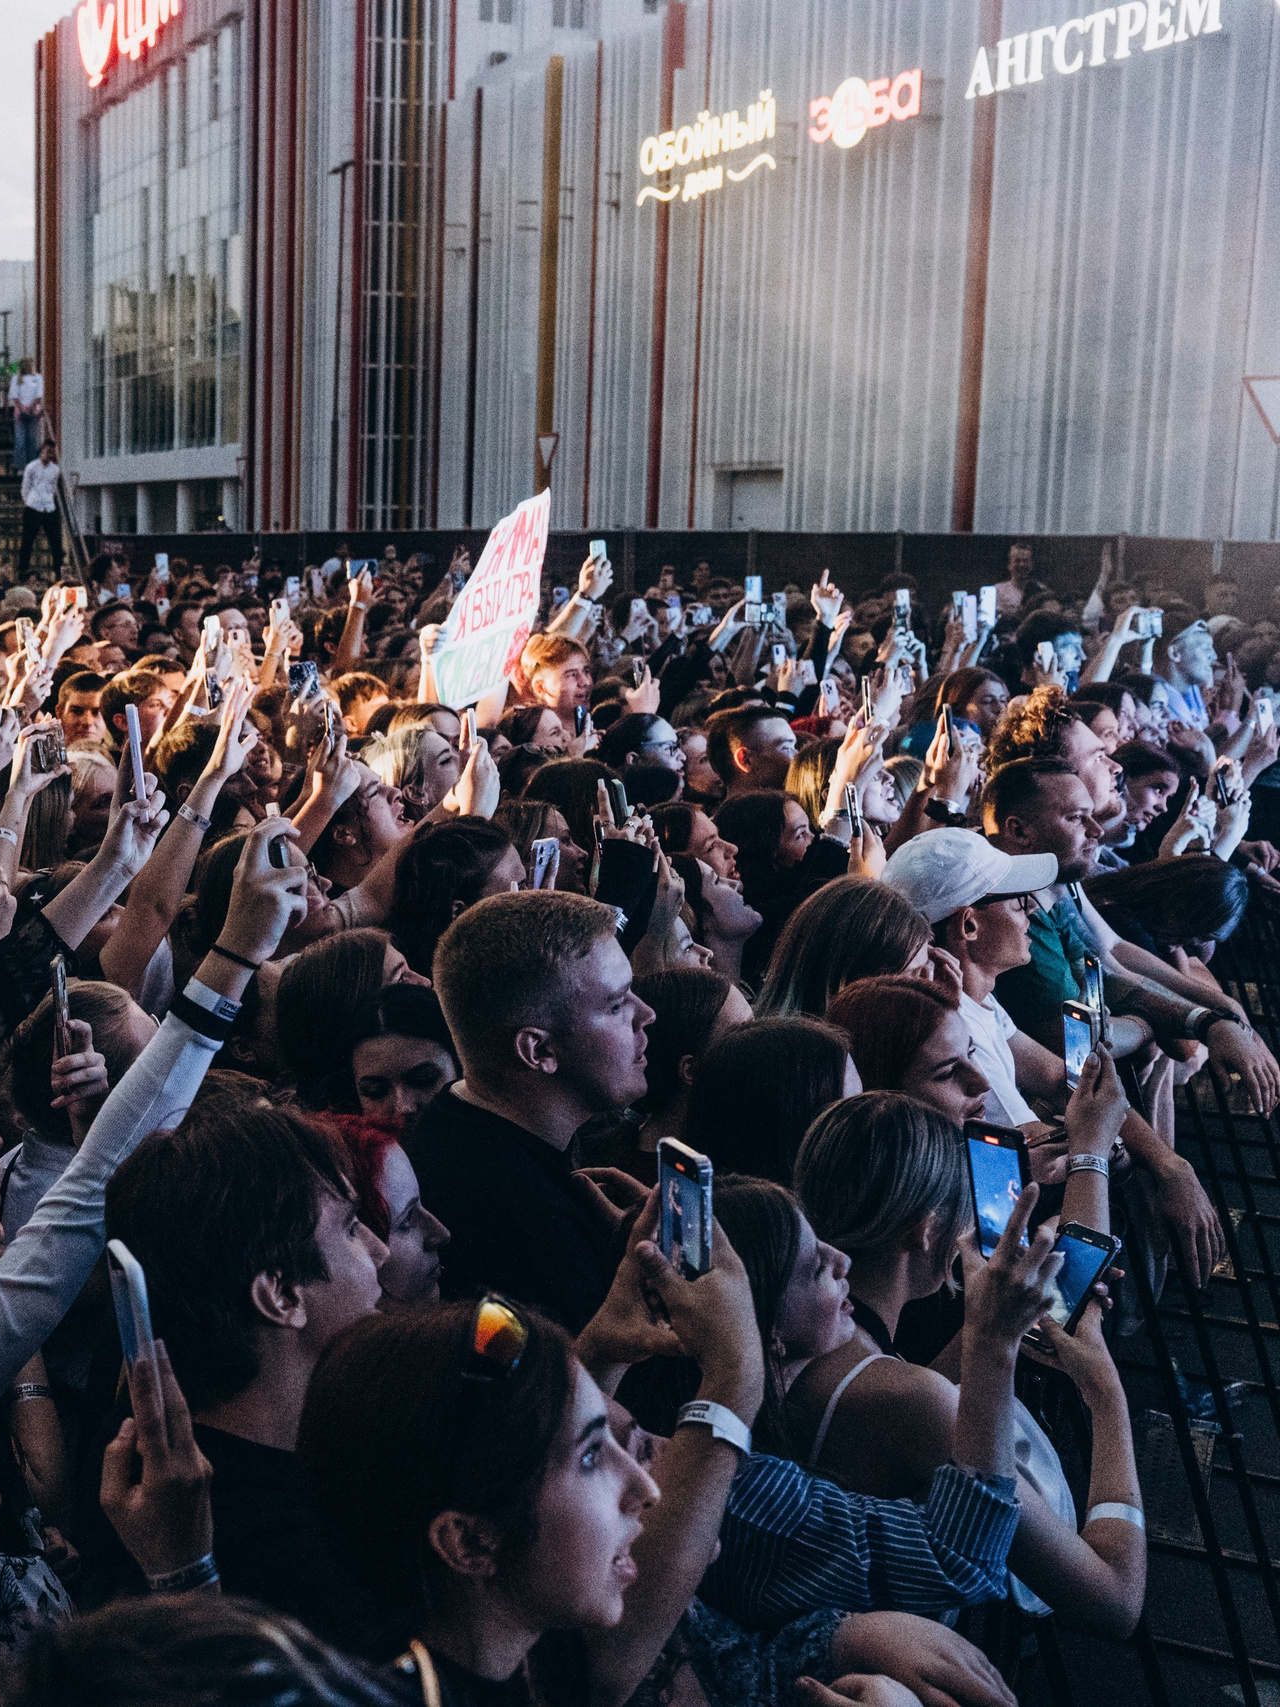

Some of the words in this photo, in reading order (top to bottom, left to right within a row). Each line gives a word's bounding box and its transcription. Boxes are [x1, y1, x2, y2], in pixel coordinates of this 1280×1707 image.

[965, 0, 1222, 99] АНГСТРЕМ
[639, 88, 776, 176] ОБОЙНЫЙ
[471, 567, 541, 633] ВЫИГРА
